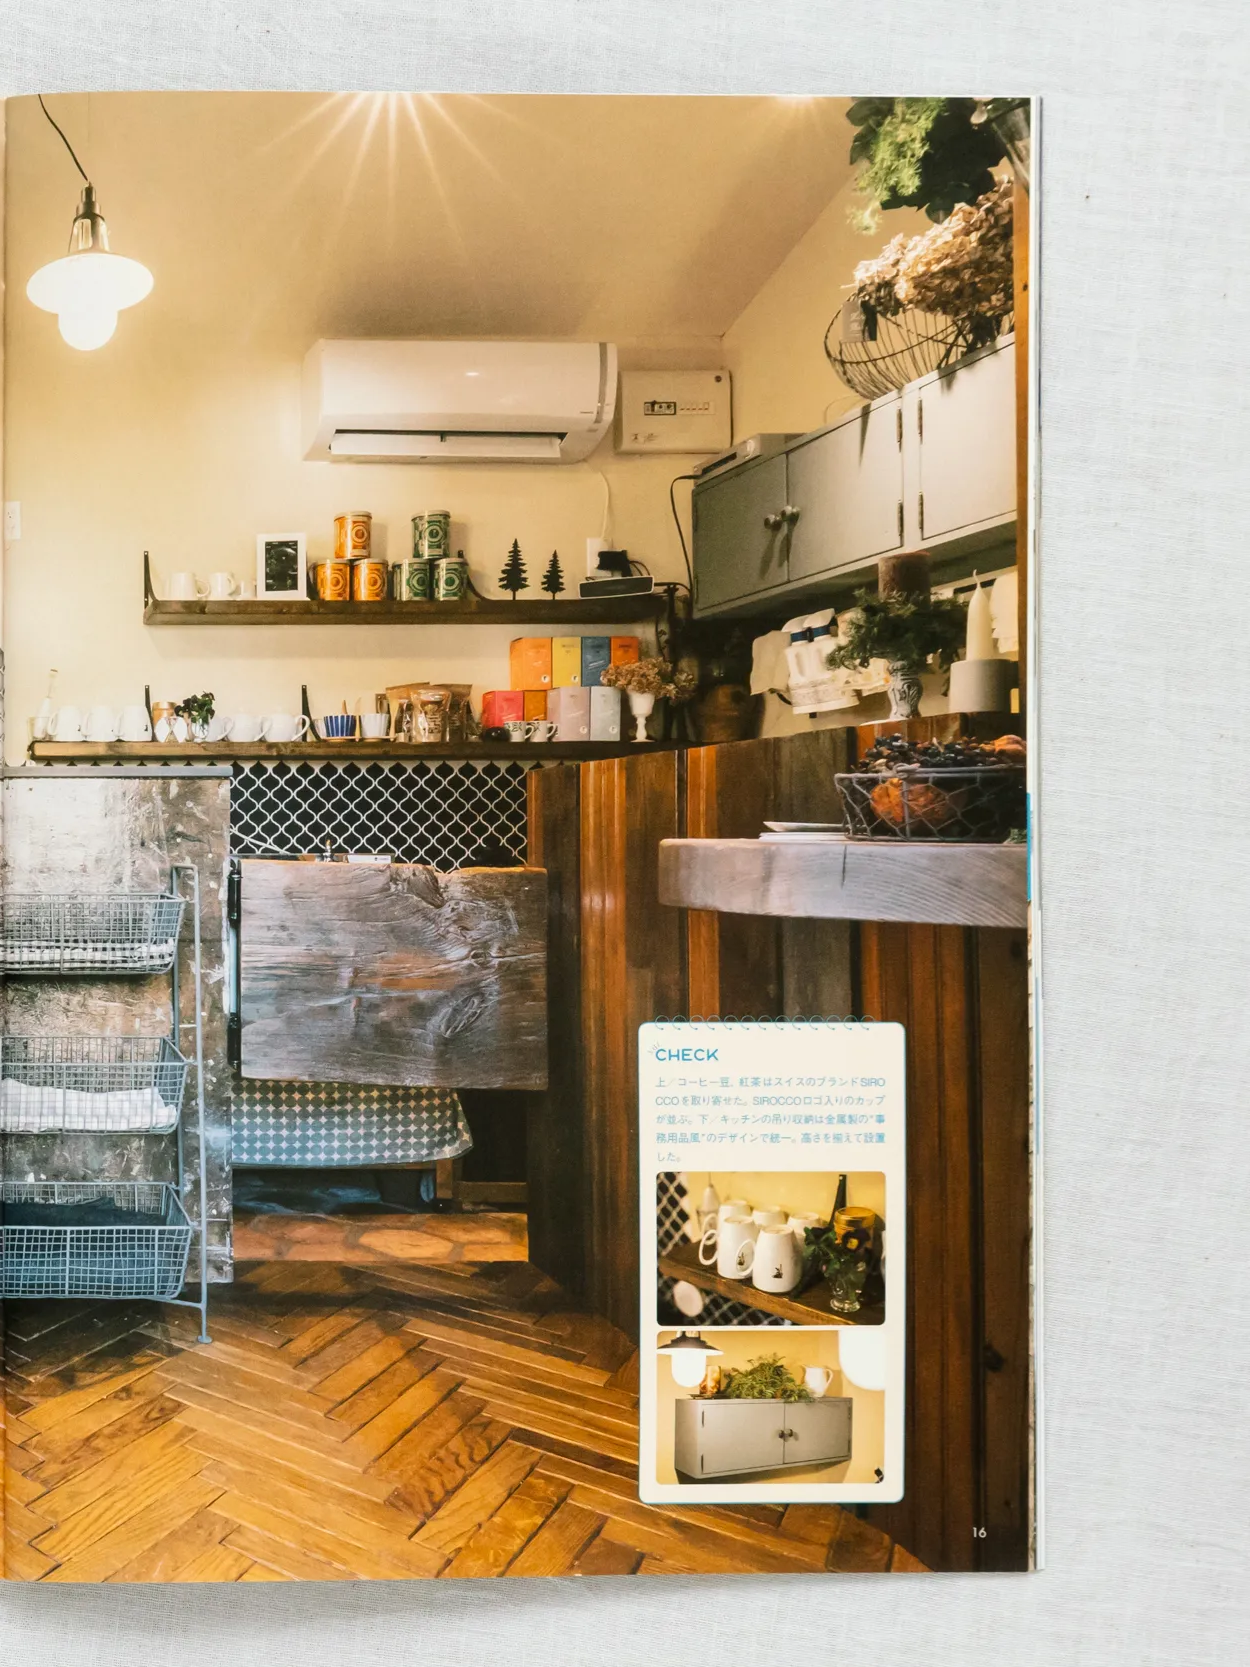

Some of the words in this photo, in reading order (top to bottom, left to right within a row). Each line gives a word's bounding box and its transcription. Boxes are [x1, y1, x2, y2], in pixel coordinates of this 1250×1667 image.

[655, 1048, 719, 1061] CHECK
[657, 1151, 682, 1163] した。
[972, 1526, 987, 1539] 16
